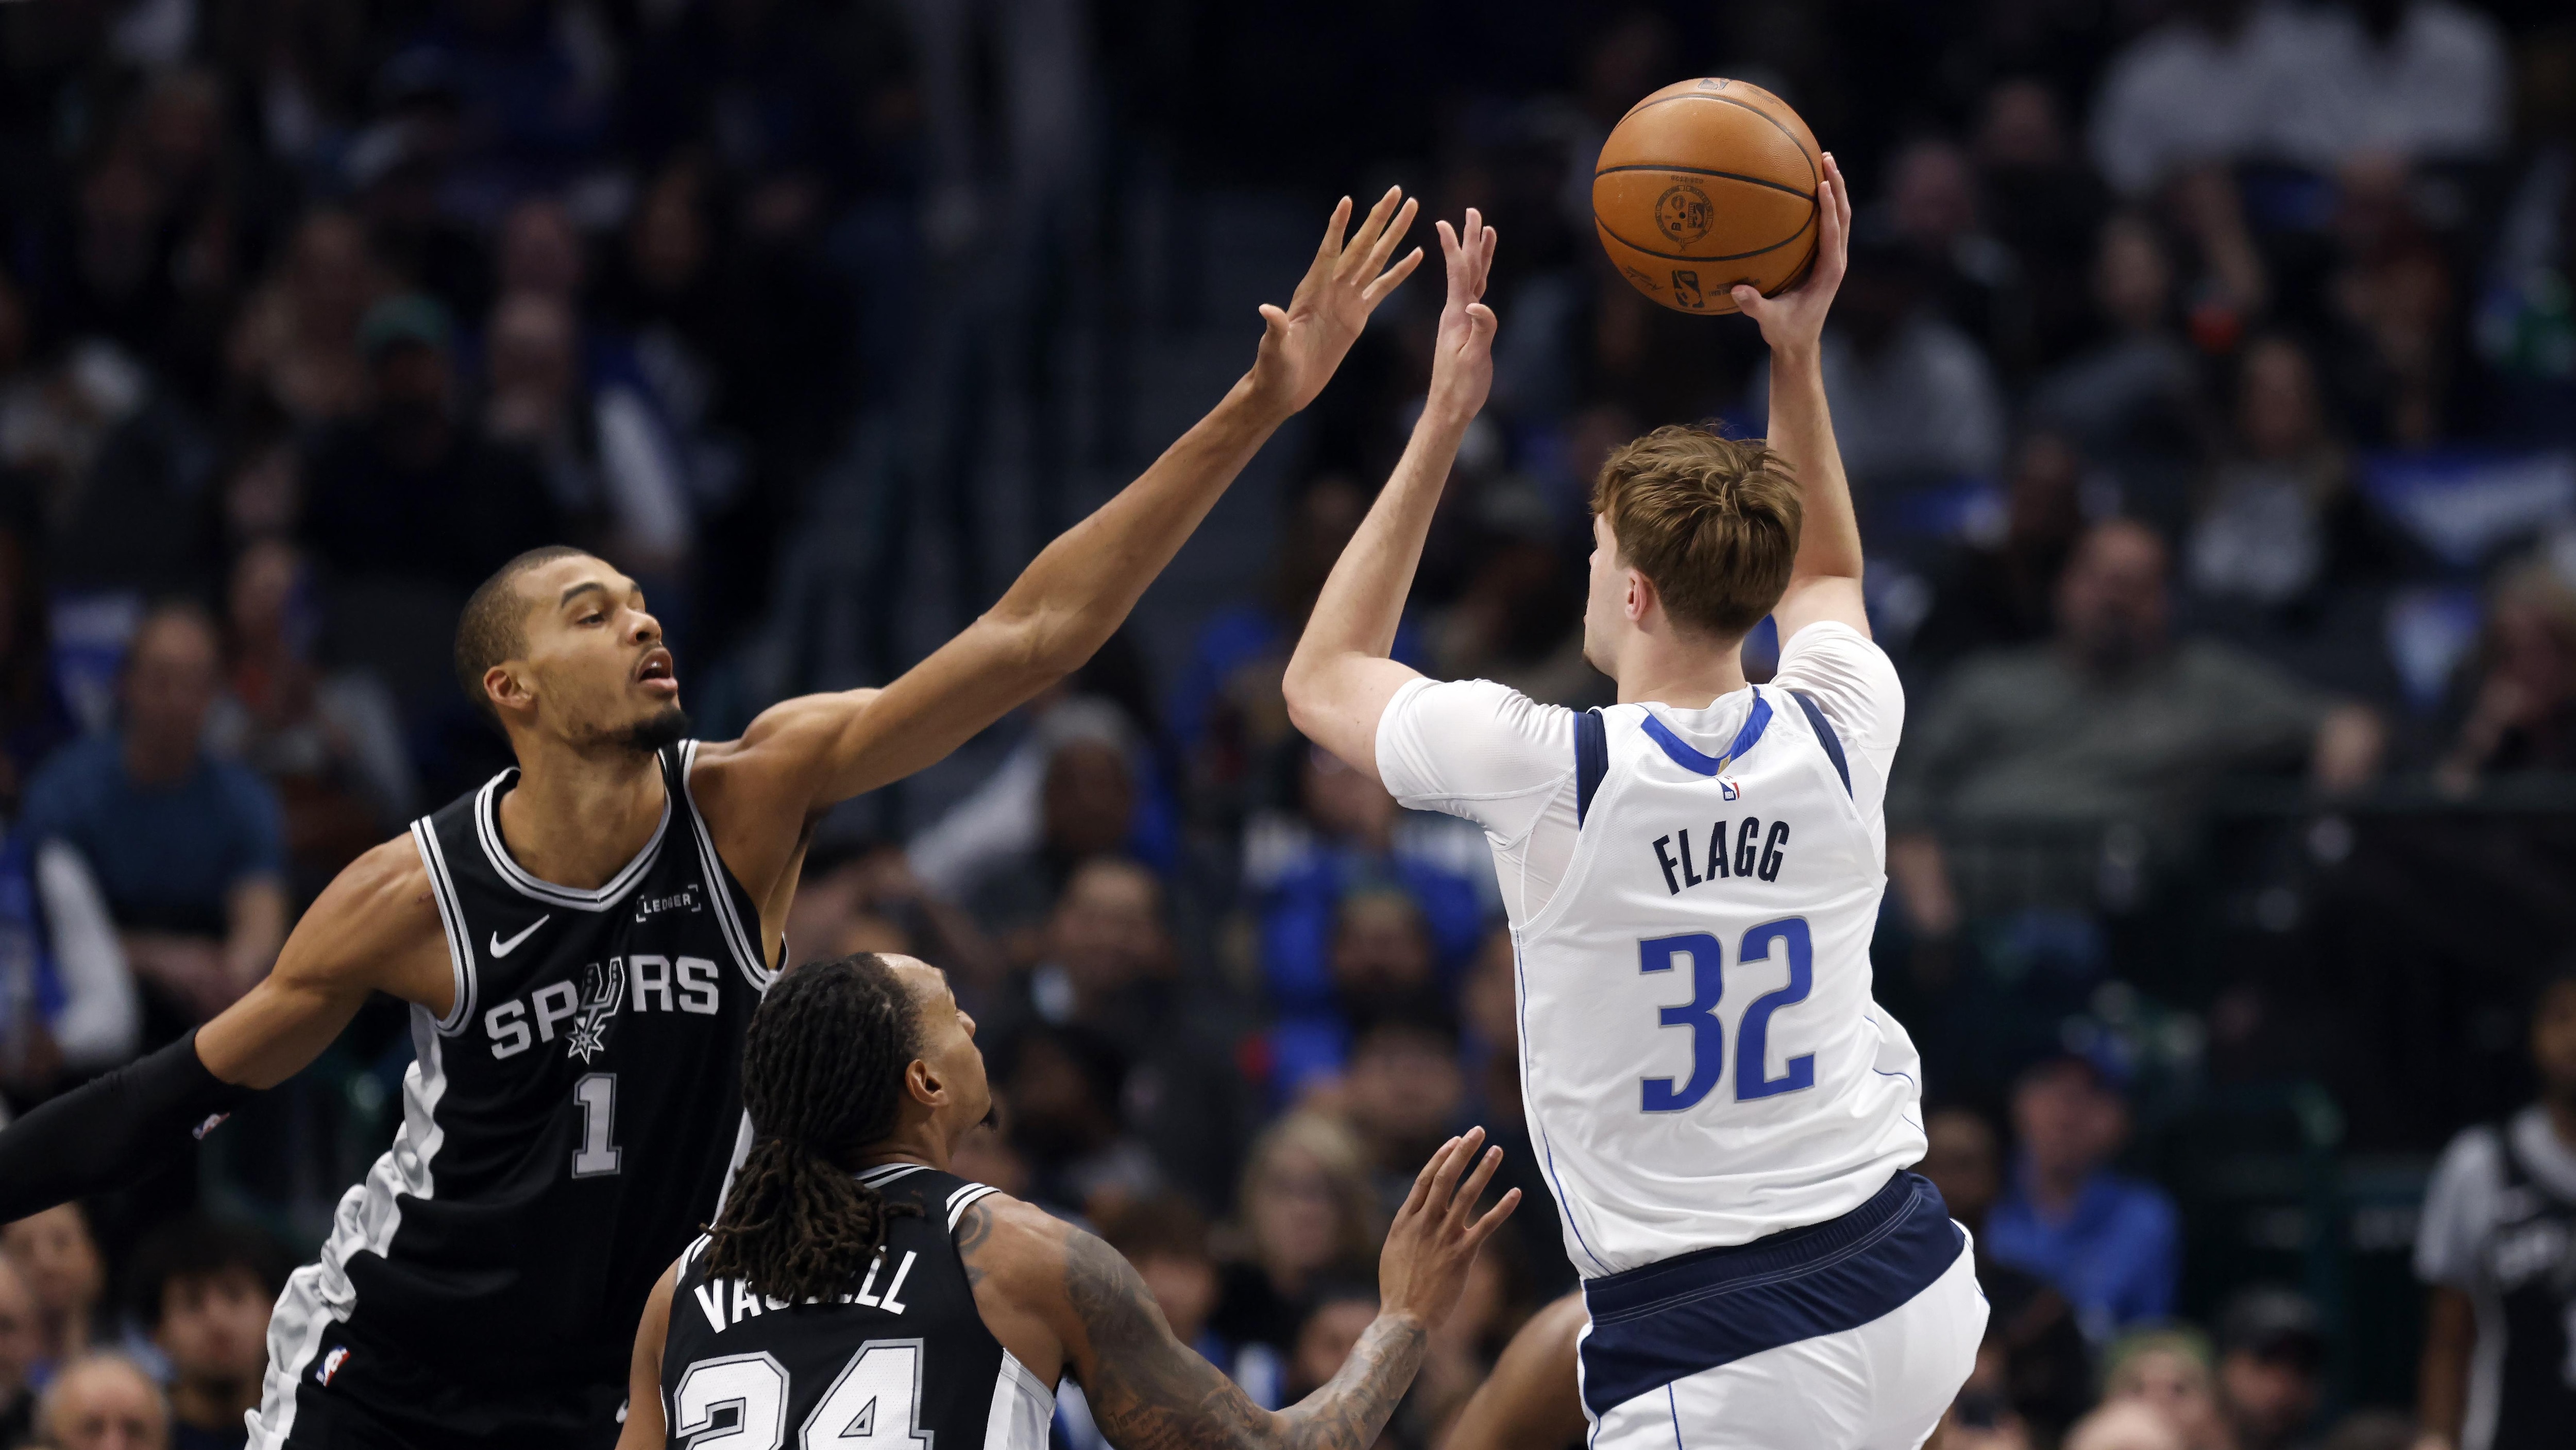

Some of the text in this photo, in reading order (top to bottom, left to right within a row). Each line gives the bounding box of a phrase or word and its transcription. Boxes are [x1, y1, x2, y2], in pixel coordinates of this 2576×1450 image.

[1725, 791, 1735, 799] NBA
[1652, 816, 1789, 895] FLAGG
[485, 954, 719, 1064] SPURS
[1638, 915, 1816, 1114] 32
[572, 1072, 622, 1179] 1
[694, 1250, 917, 1333] VALL
[673, 1338, 934, 1450] 24
